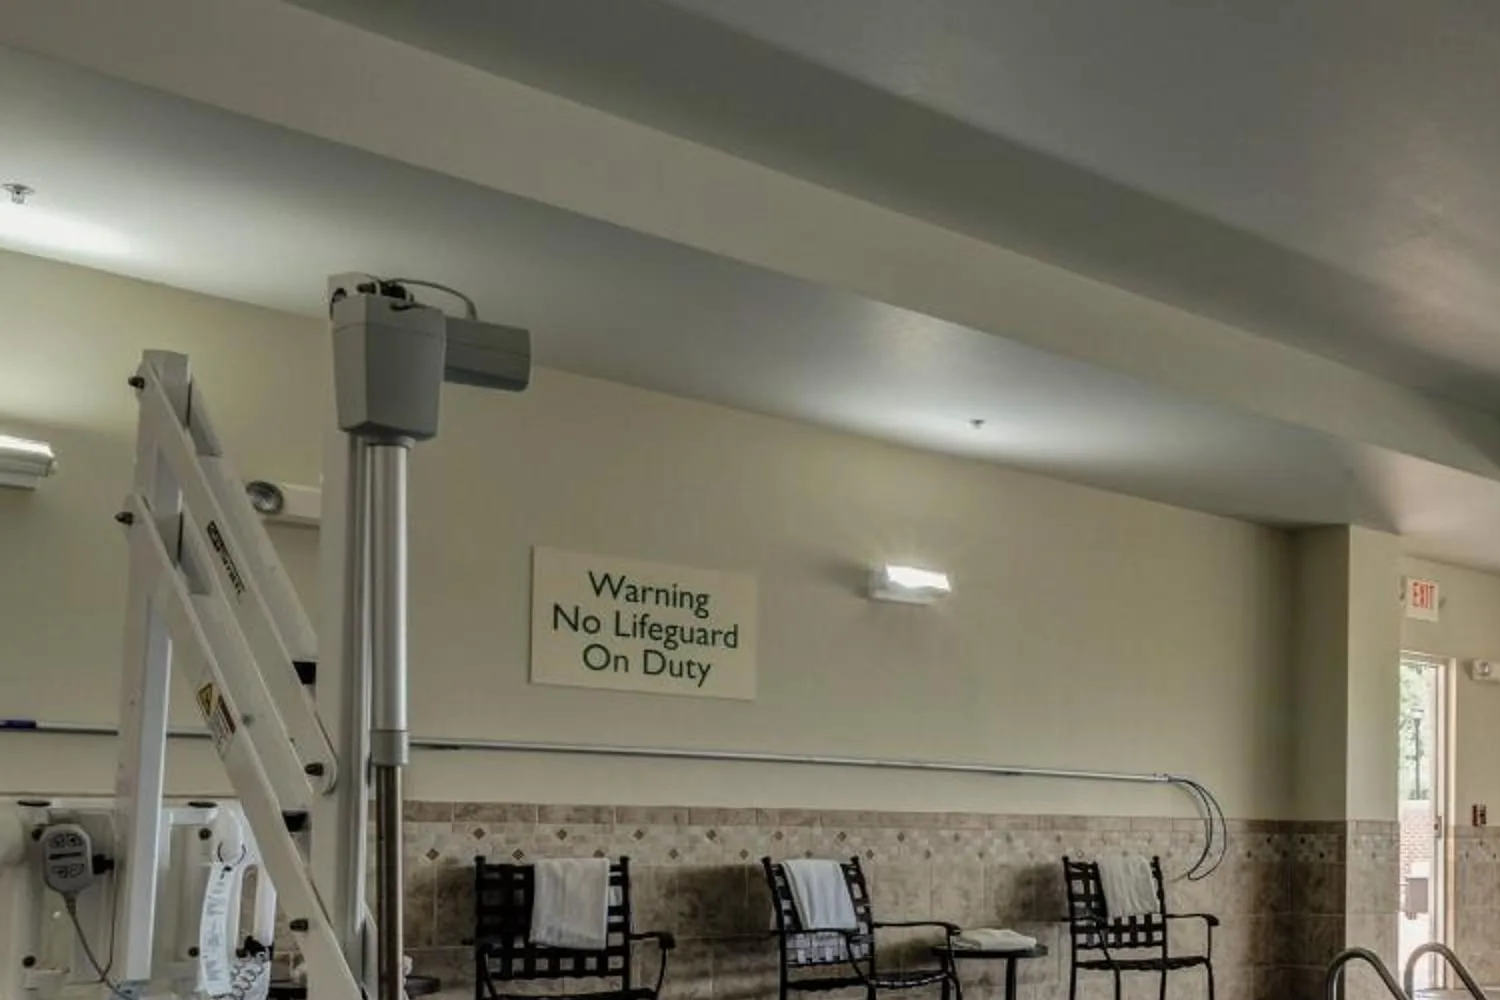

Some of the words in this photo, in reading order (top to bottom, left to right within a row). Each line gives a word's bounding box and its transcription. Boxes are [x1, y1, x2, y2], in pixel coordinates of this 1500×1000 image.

[588, 570, 710, 619] Warning
[1411, 581, 1435, 610] EXIT
[553, 603, 600, 634] No
[615, 610, 739, 650] Lifeguard
[583, 643, 629, 673] On
[643, 649, 711, 688] Duty
